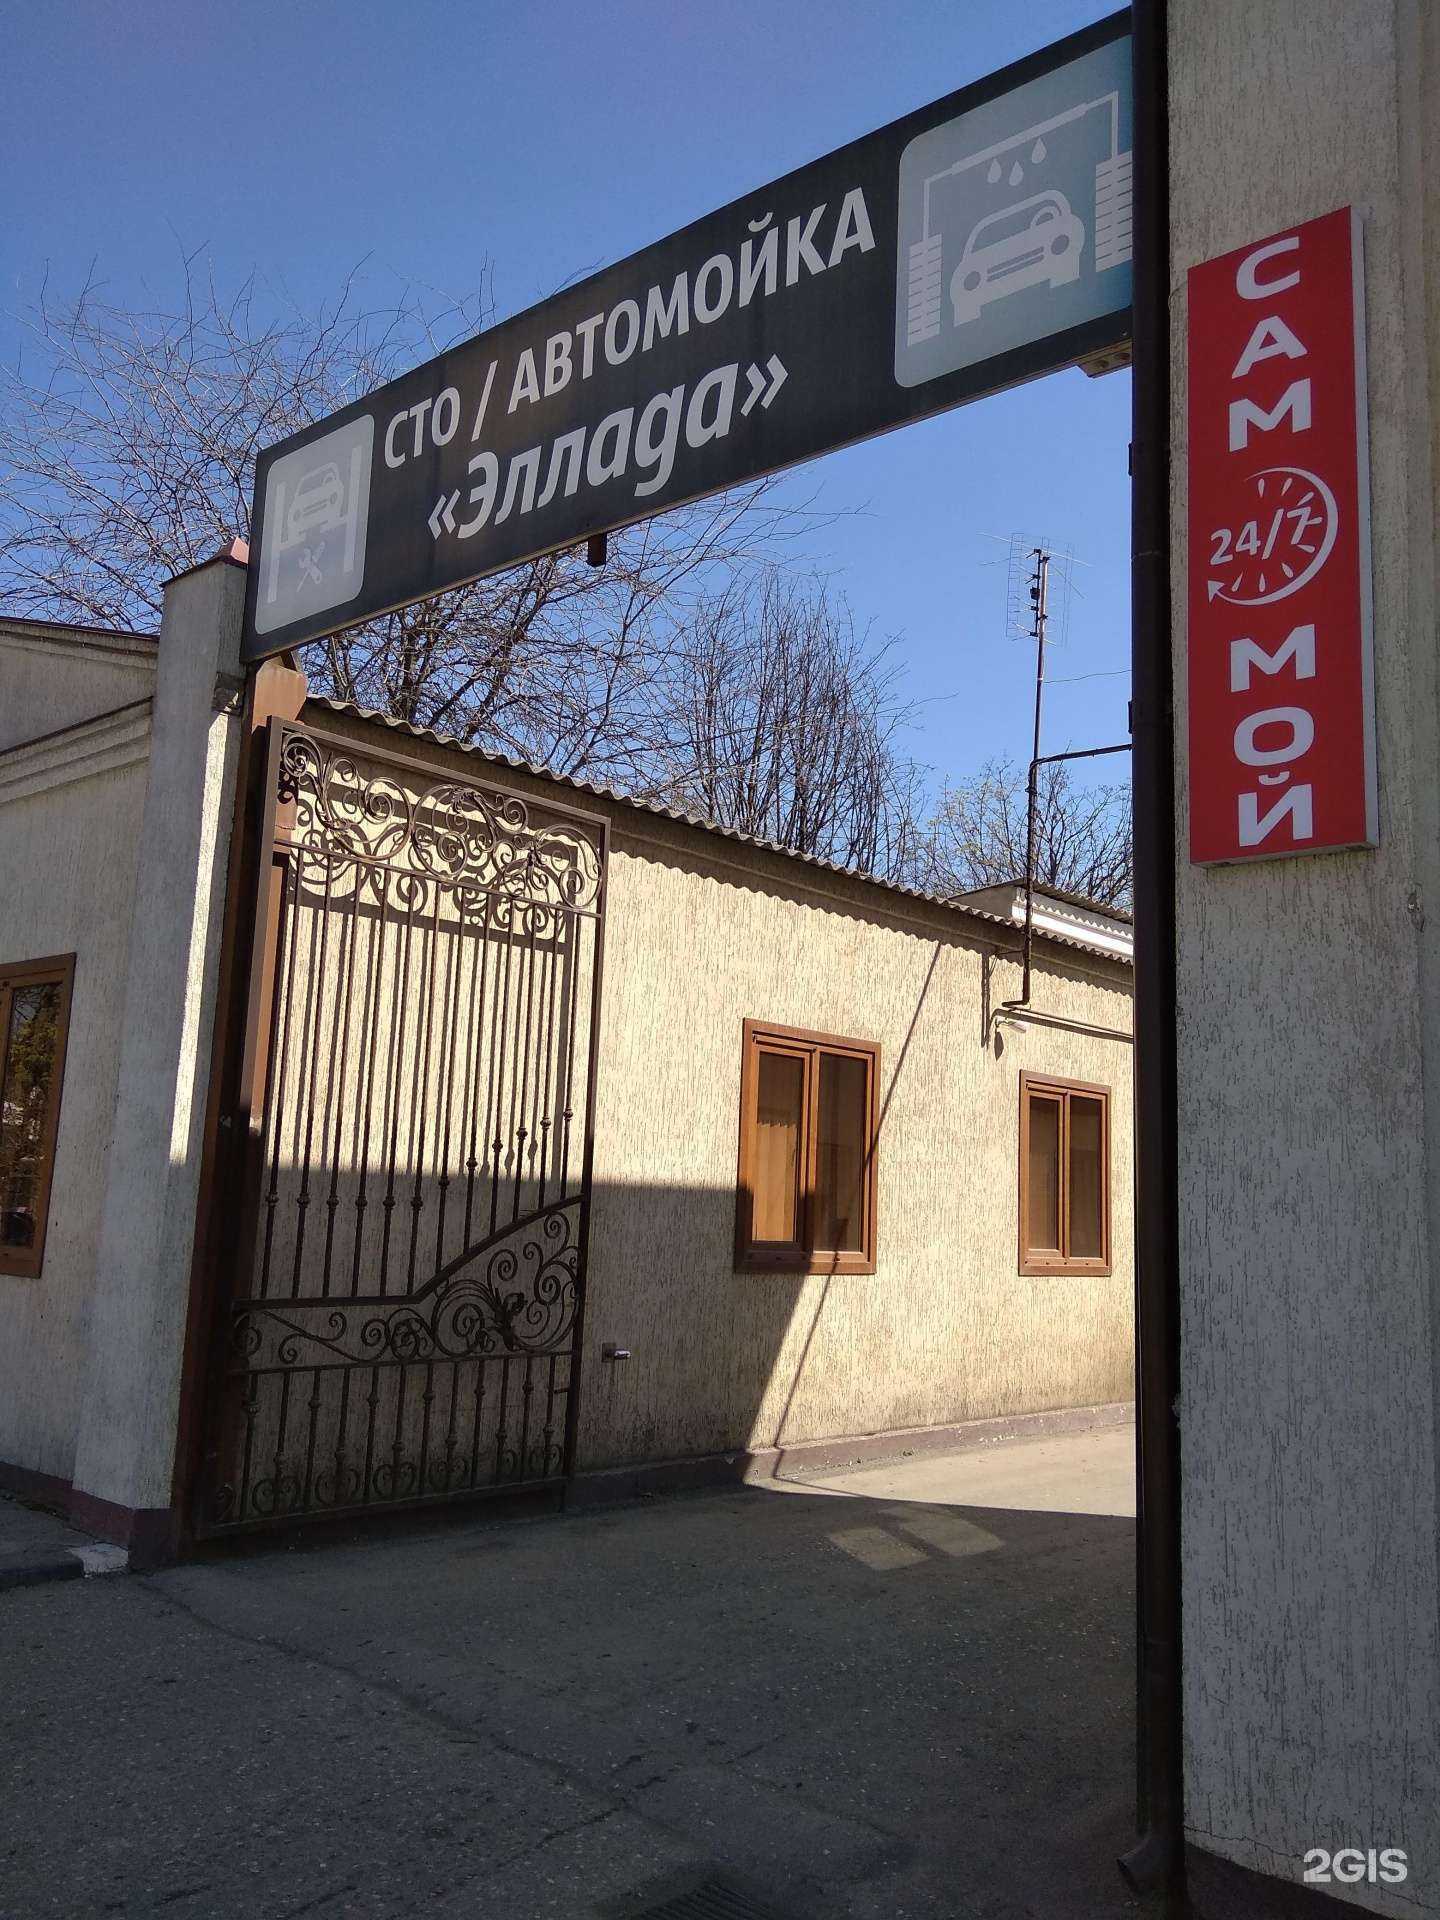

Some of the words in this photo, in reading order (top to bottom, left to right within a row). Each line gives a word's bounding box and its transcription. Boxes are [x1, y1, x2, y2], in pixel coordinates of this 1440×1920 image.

[384, 387, 460, 469] СТО
[470, 359, 498, 441] /
[507, 187, 877, 414] АВТОМОЙКА
[1229, 236, 1312, 453] САМ
[427, 354, 789, 540] «Эллада»
[1210, 505, 1313, 566] 24/7
[1230, 623, 1316, 848] МОЙ
